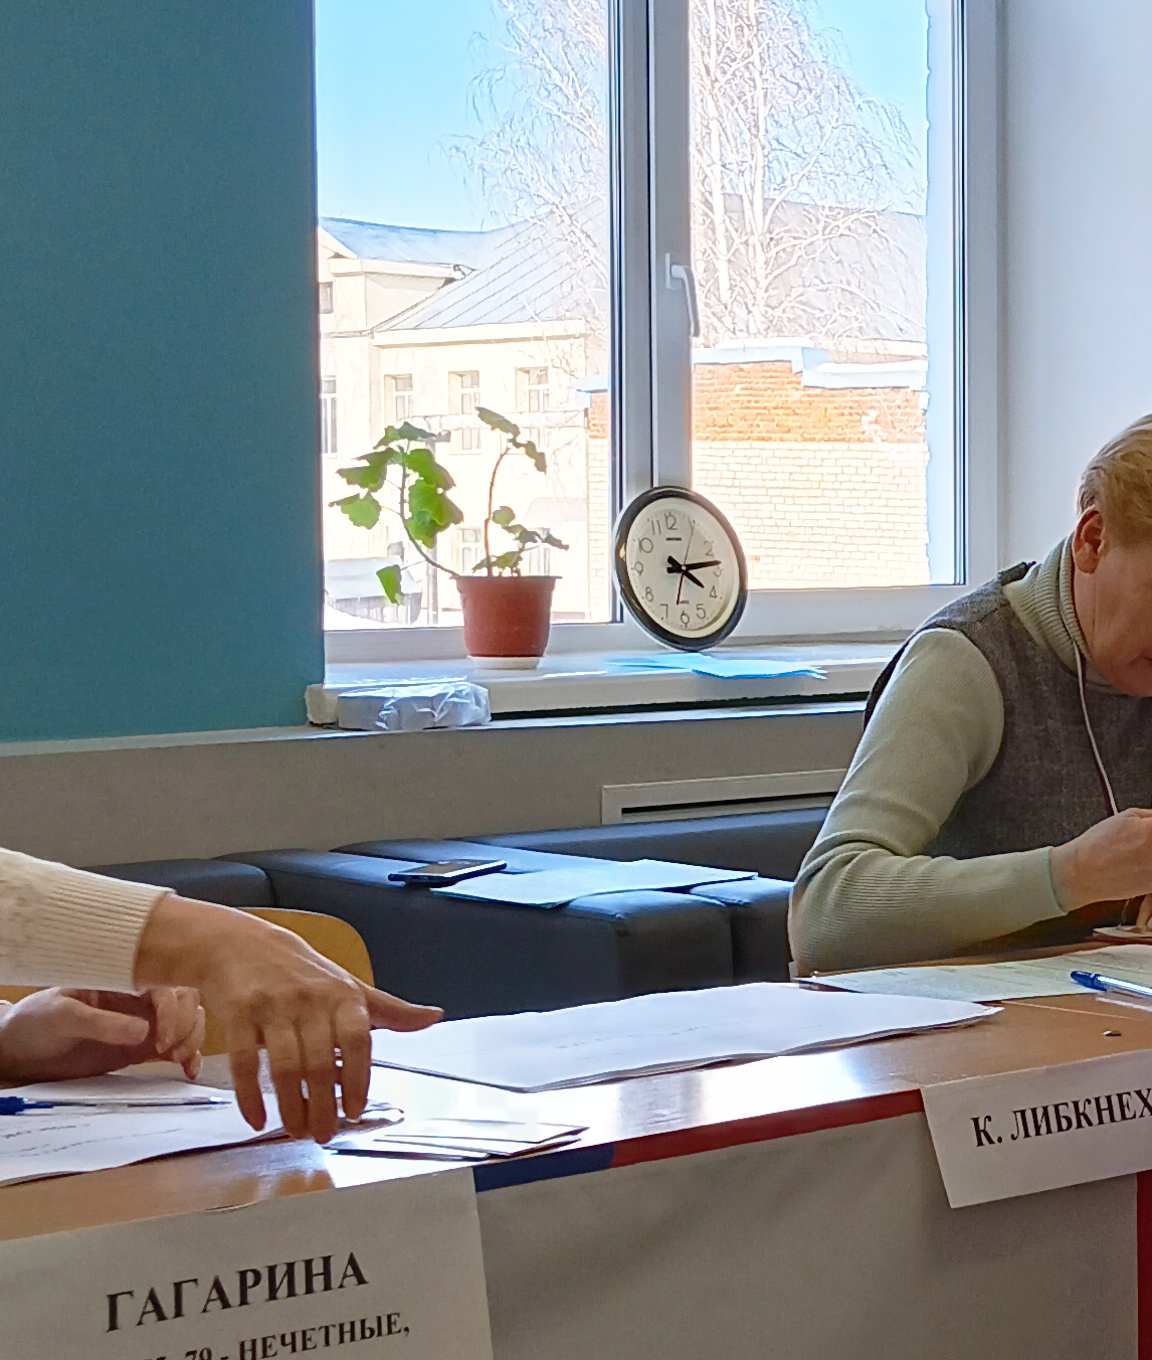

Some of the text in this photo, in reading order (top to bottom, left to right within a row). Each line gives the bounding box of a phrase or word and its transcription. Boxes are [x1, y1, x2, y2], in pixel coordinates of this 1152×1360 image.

[704, 540, 714, 557] 2
[645, 586, 654, 602] 8
[708, 585, 718, 600] 4
[659, 603, 669, 619] 7
[696, 603, 707, 620] 5
[971, 1115, 1003, 1147] К.
[106, 1251, 369, 1333] ГАГАРИНА
